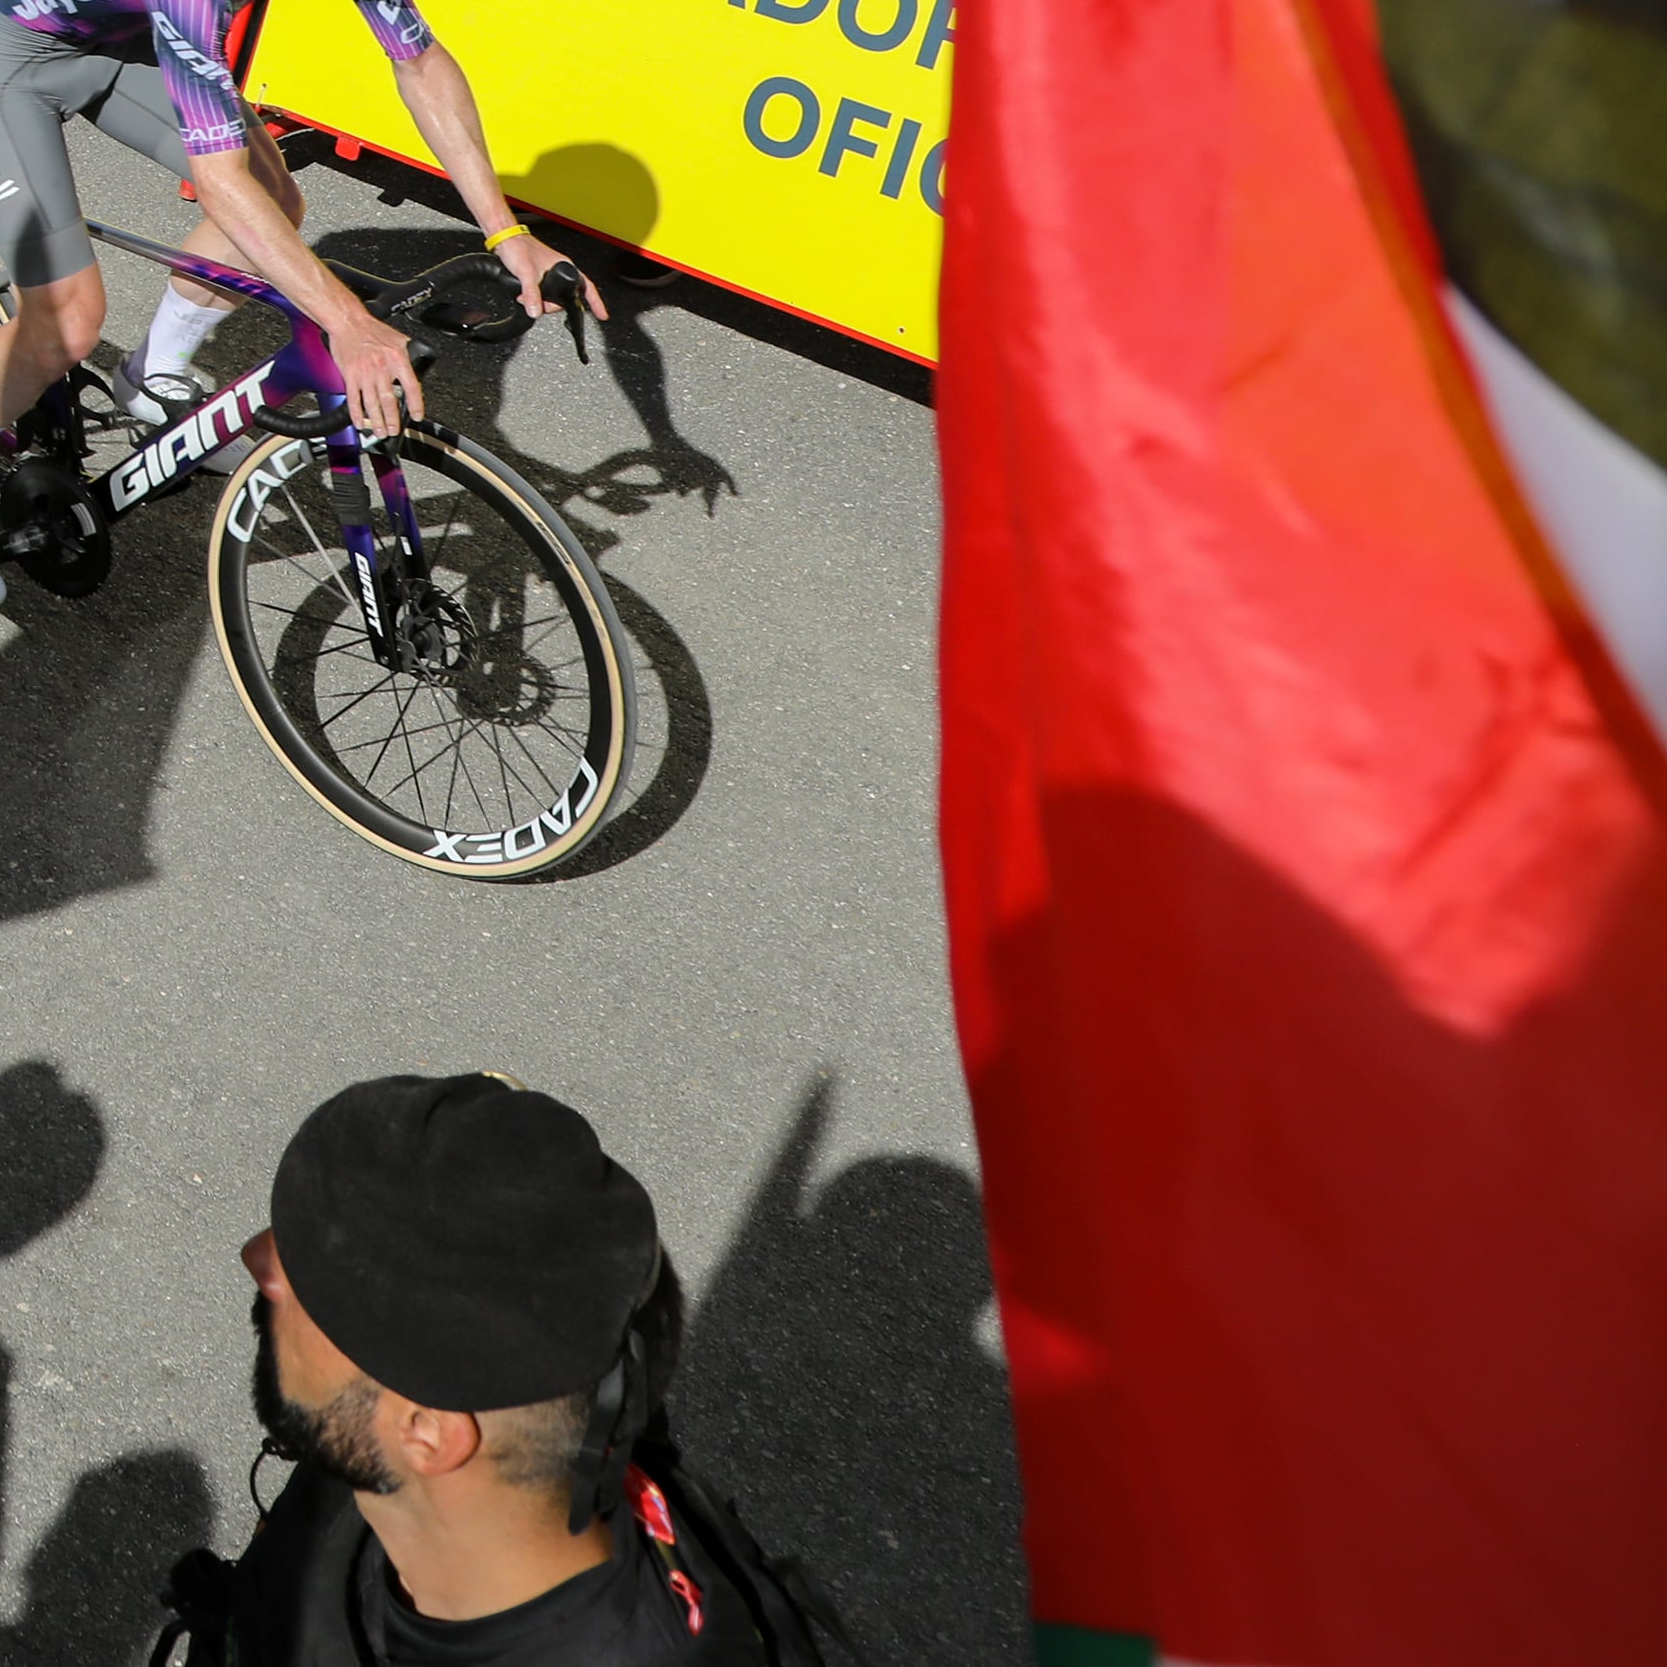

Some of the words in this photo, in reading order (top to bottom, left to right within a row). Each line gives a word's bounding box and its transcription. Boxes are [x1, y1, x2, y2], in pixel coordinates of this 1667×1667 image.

[110, 359, 276, 512] GIANT
[353, 551, 384, 637] GIANT
[423, 756, 600, 864] CADEX
